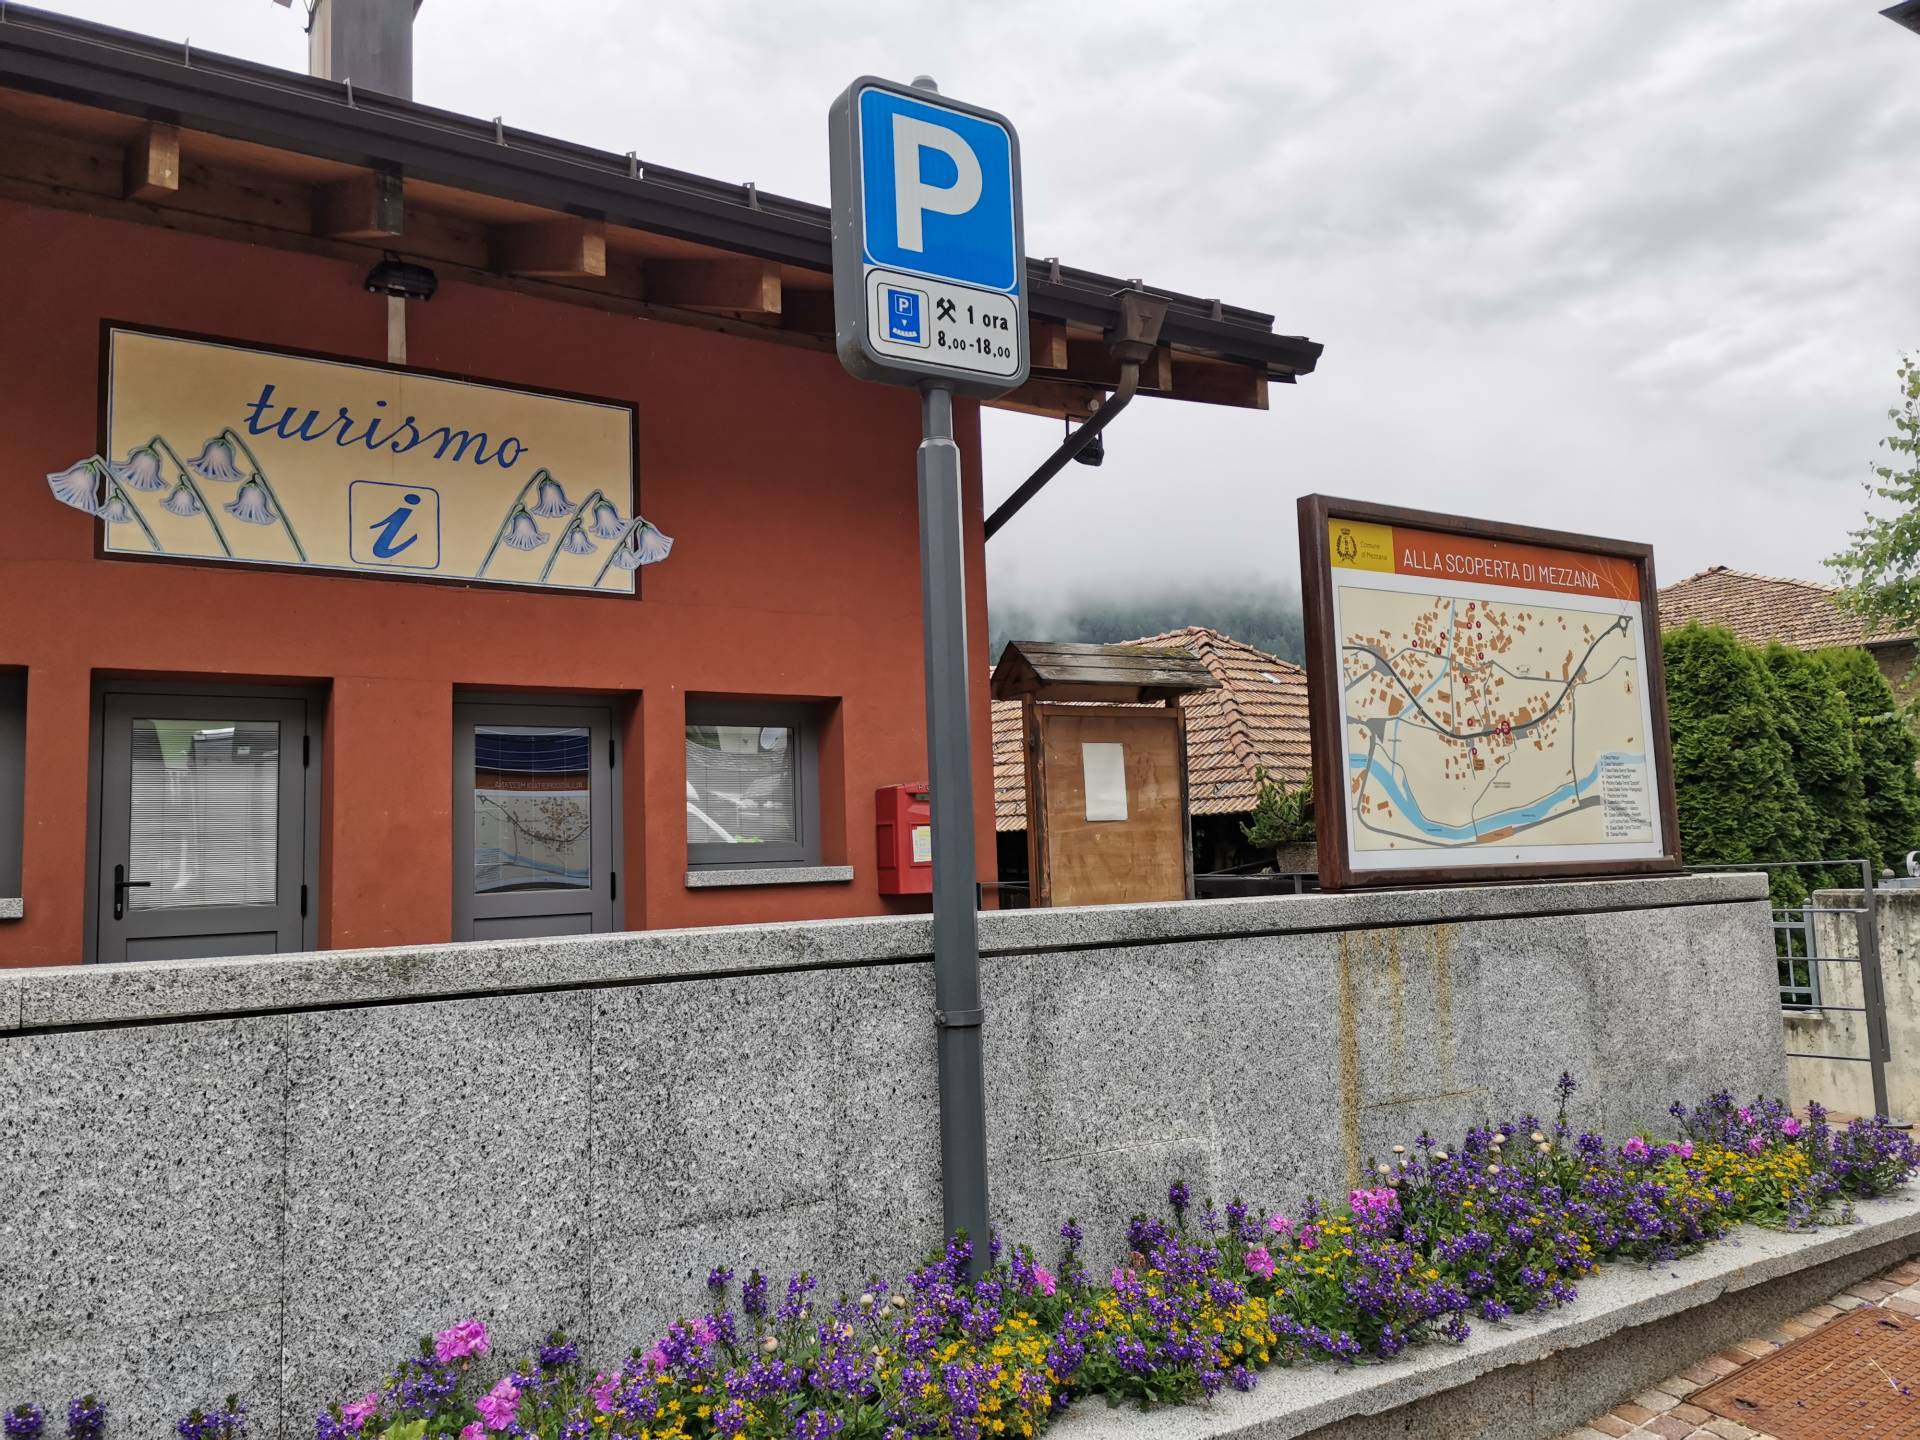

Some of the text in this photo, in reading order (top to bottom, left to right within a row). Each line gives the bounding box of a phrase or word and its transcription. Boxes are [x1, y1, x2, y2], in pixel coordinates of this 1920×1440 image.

[892, 112, 982, 253] P
[899, 298, 909, 313] P
[967, 305, 1009, 331] 1 ora
[244, 384, 528, 469] turismo
[369, 493, 421, 558] i
[1403, 548, 1600, 590] ALLA SCOPERTA DI MEZZANA
